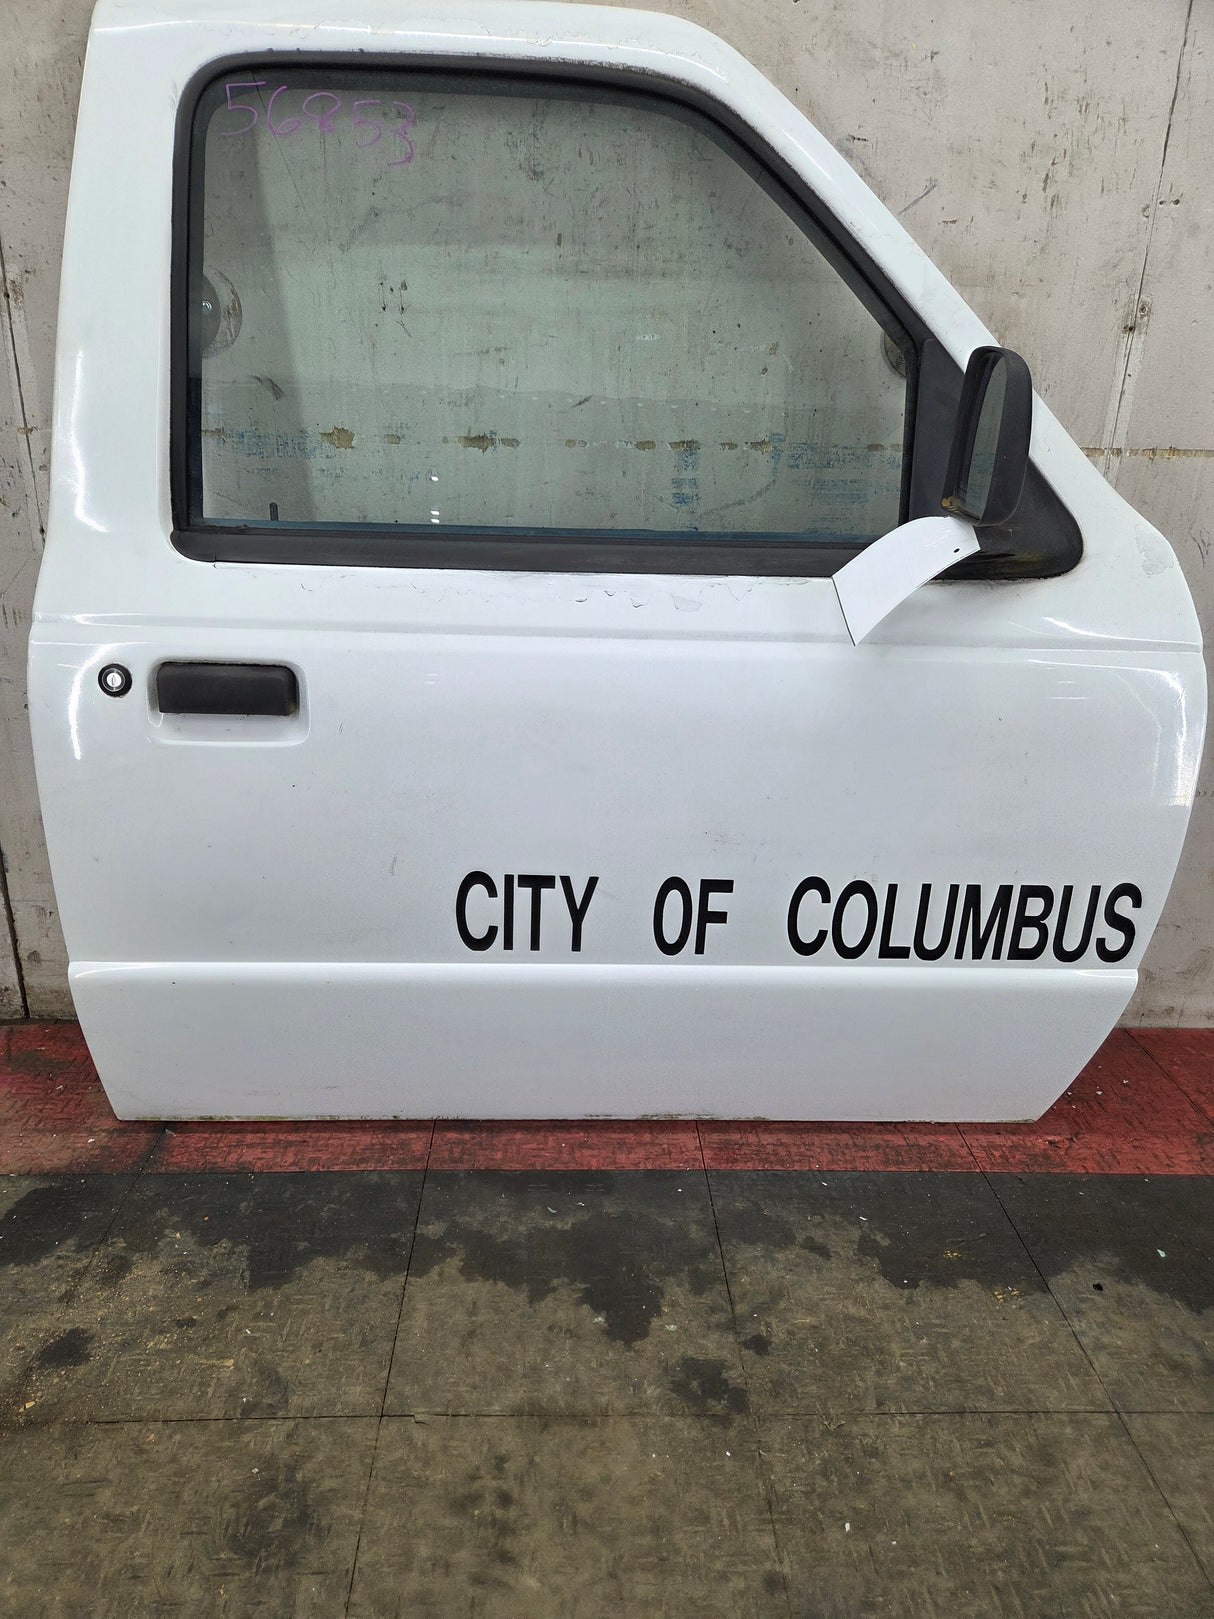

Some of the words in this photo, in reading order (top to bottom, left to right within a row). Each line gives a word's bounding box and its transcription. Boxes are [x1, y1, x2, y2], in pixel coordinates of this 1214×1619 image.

[221, 81, 416, 167] 56853
[456, 870, 600, 953] CITY
[653, 876, 734, 956] OF
[787, 876, 1143, 963] COLUMBUS
